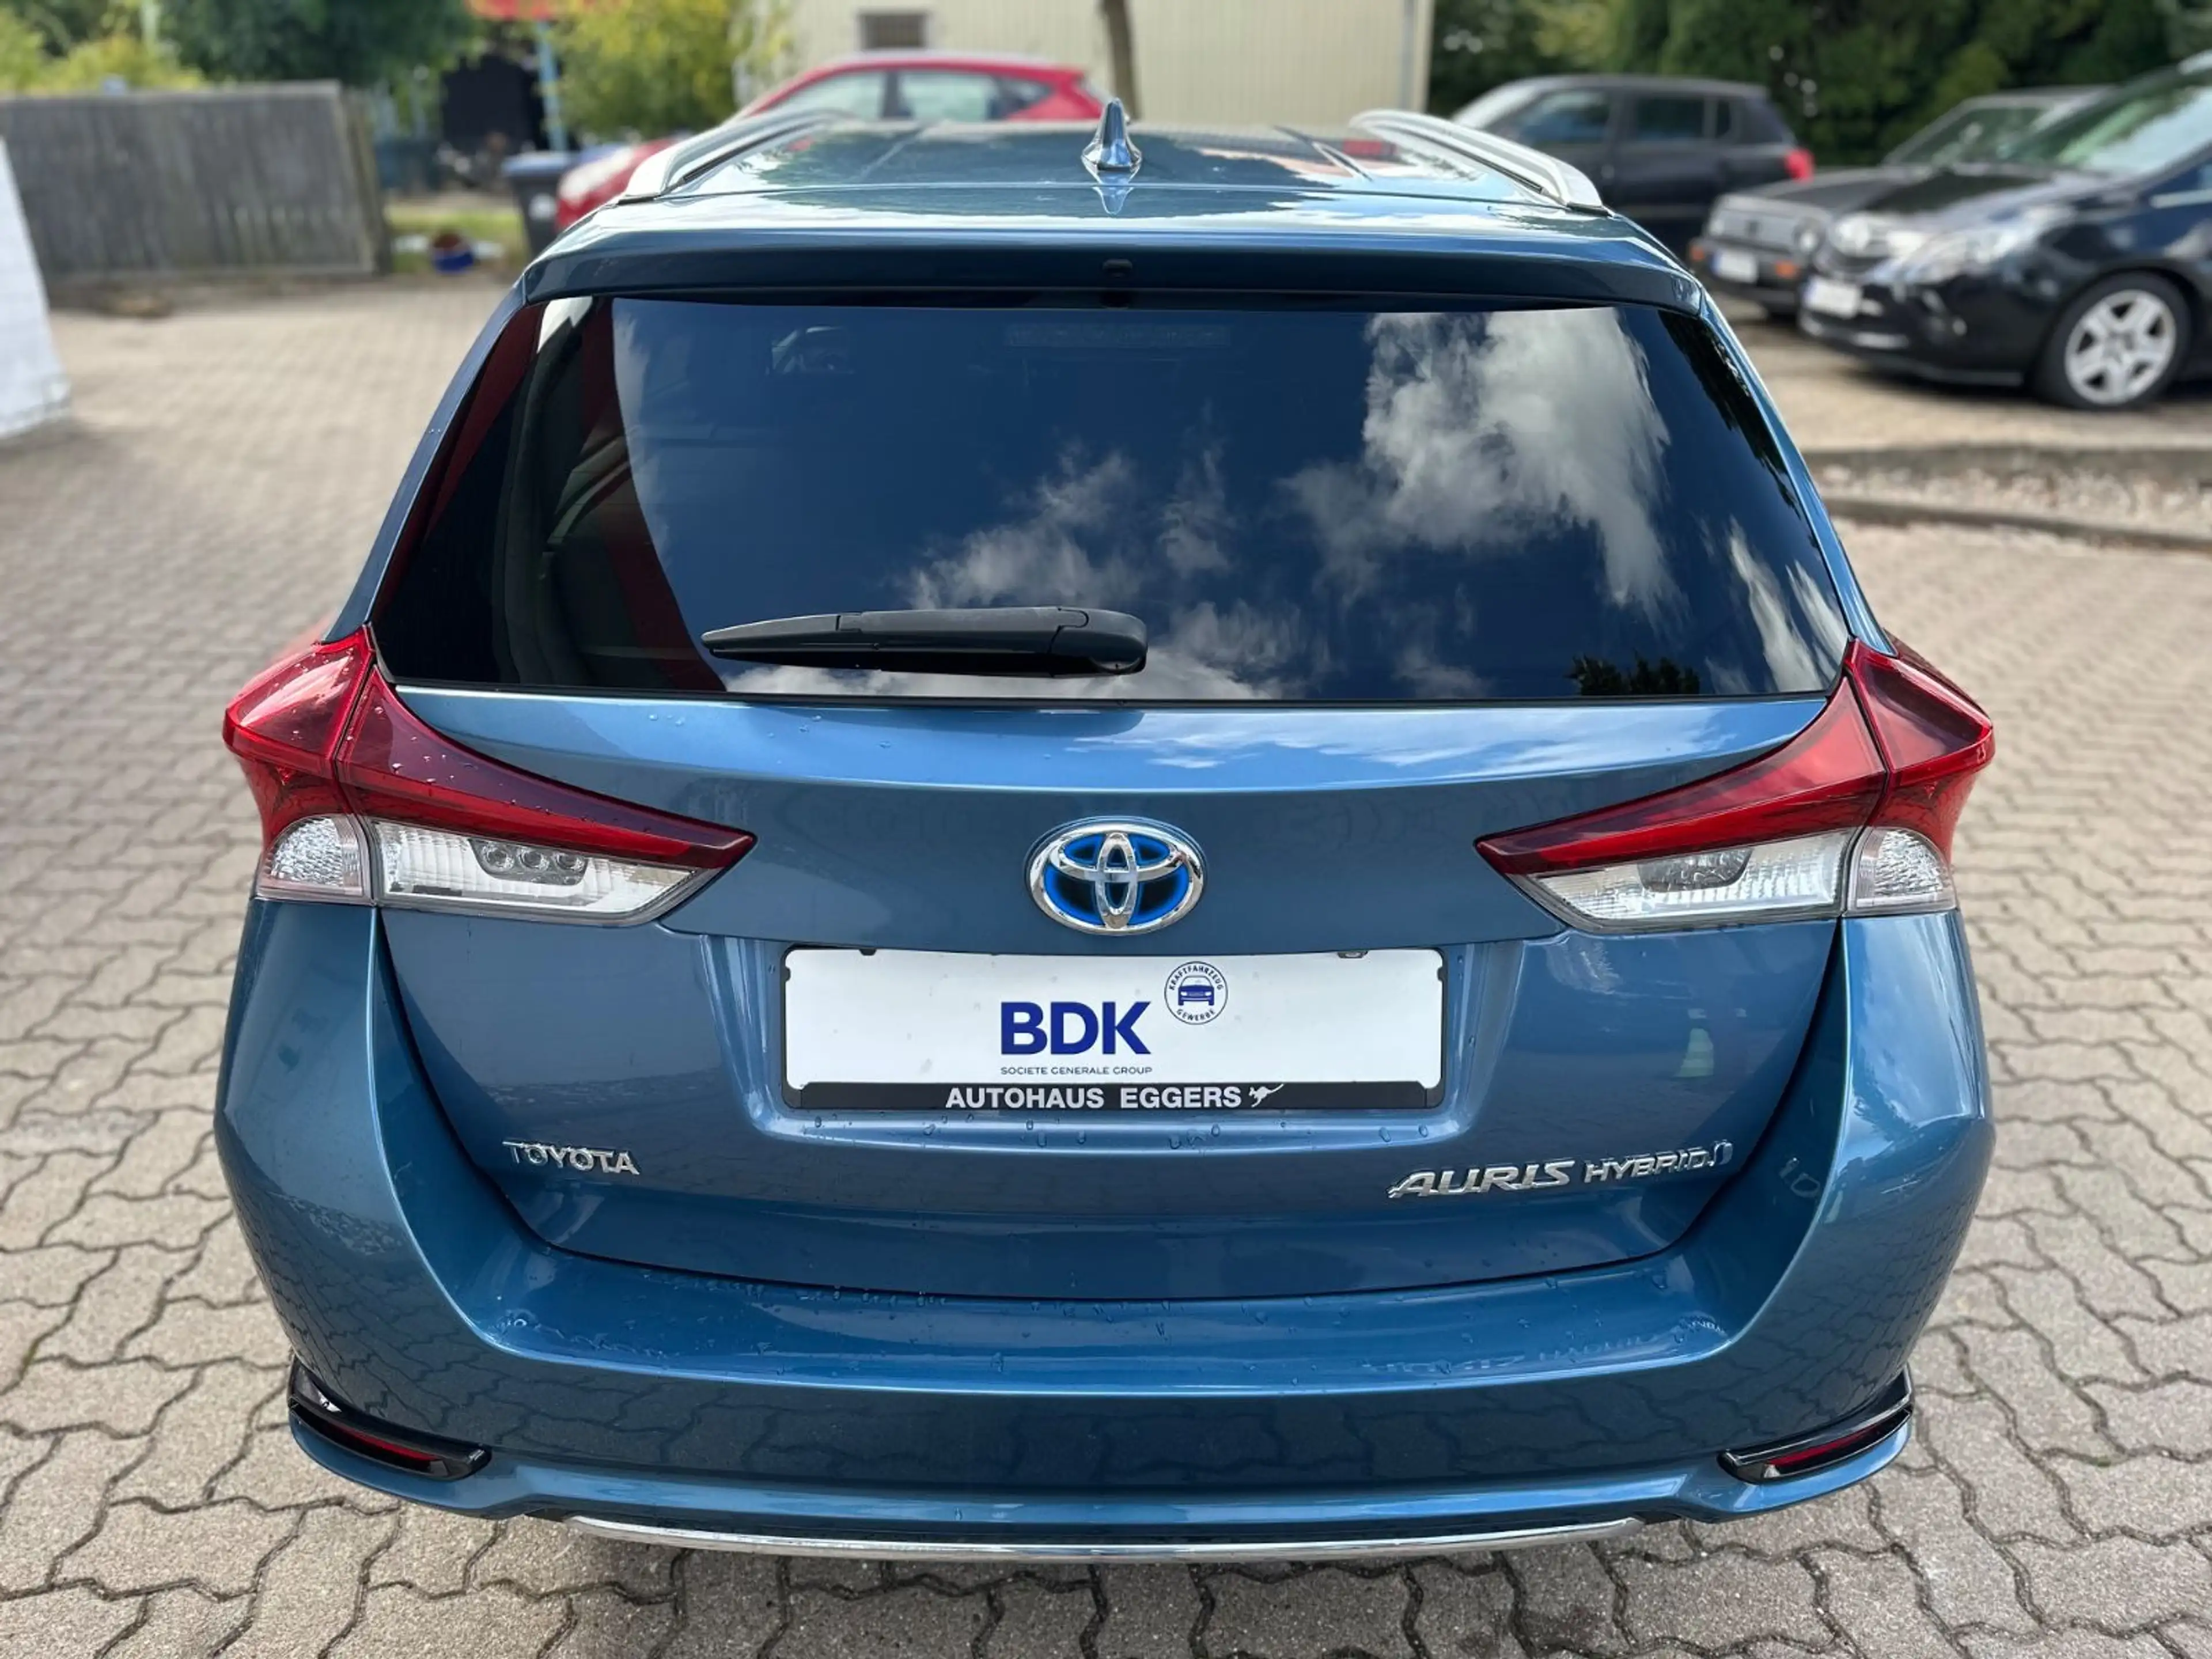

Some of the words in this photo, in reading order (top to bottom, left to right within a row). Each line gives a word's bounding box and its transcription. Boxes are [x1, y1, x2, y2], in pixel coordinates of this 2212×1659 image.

[1169, 965, 1224, 990] KRAFTFAHRZEUG
[1176, 1009, 1216, 1021] GEWERBE
[1001, 1001, 1152, 1055] BDK
[1001, 1066, 1048, 1075] SOCIETE
[1050, 1066, 1110, 1075] GENERALE
[1112, 1066, 1153, 1075] GROUP
[945, 1087, 1105, 1109] AUTOHAUS
[1120, 1086, 1242, 1109] EGGERS
[502, 1140, 640, 1176] TOYOTA
[1387, 1158, 1575, 1199] AURIS
[1584, 1146, 1712, 1183] HYBRID
